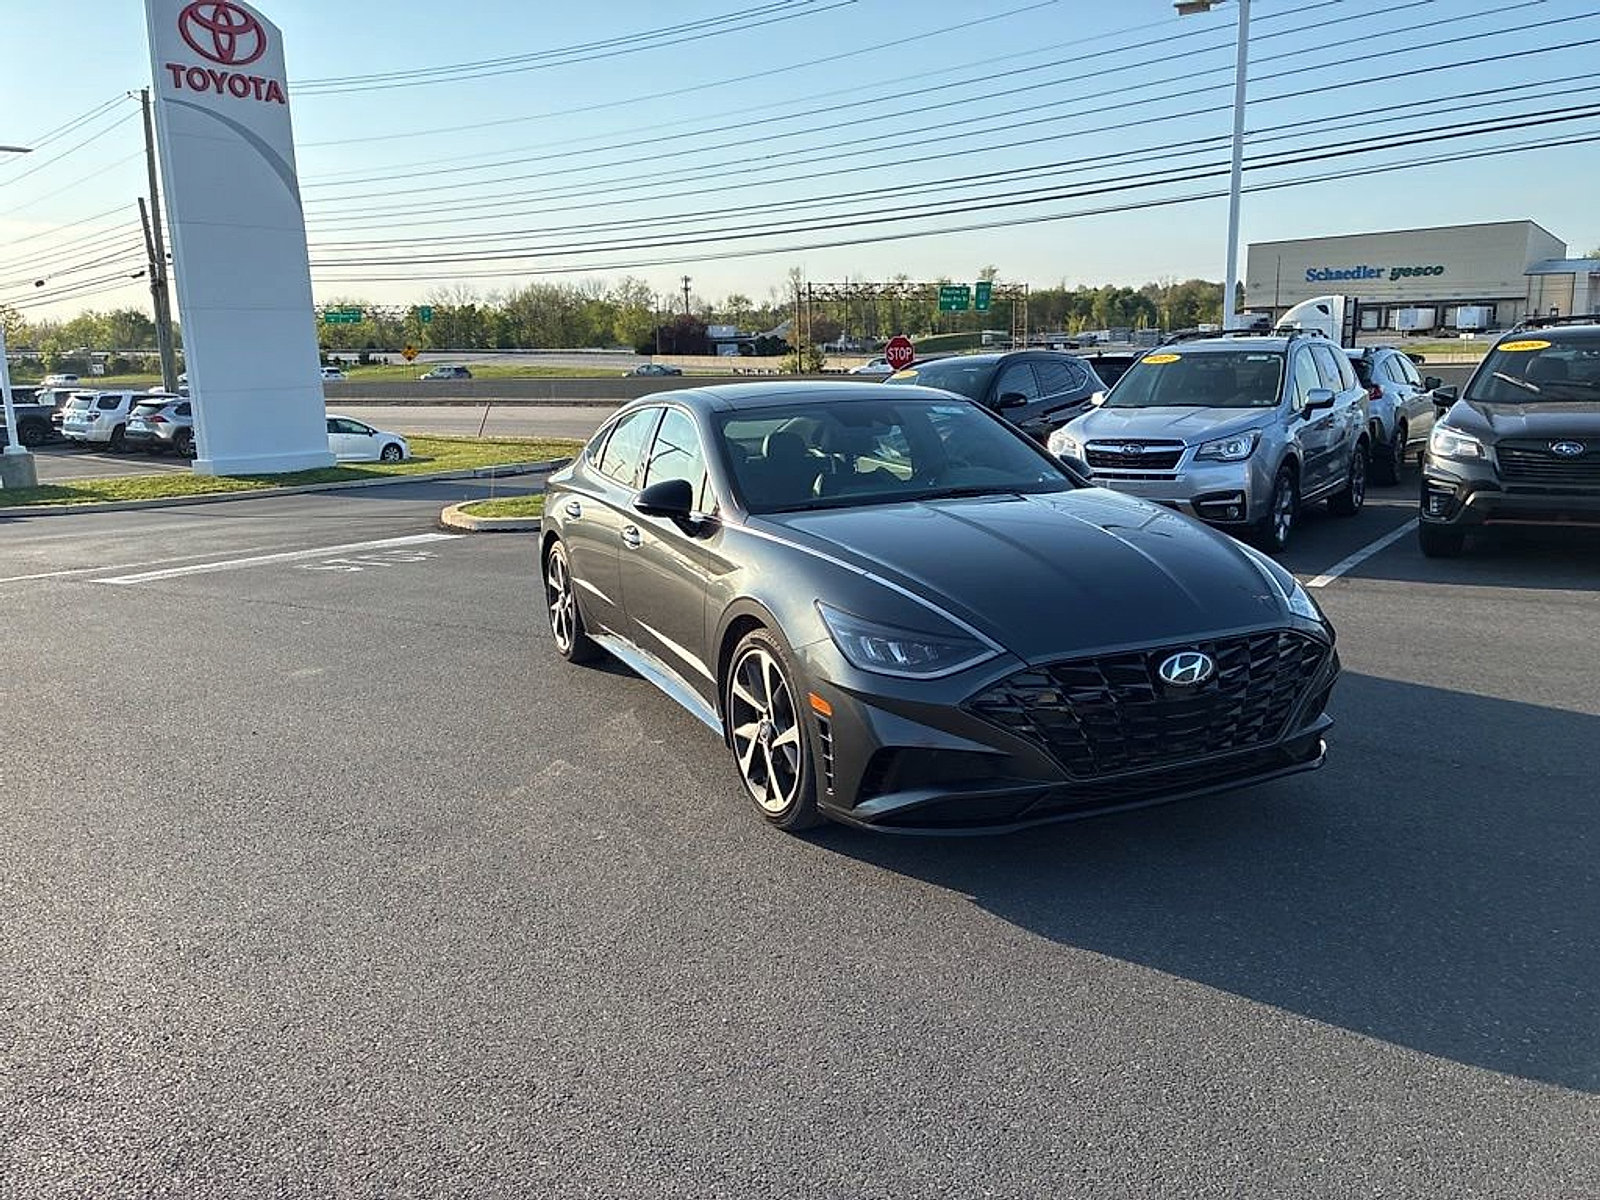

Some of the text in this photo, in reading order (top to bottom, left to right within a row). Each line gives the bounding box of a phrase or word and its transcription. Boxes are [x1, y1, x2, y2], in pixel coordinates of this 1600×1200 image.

[166, 63, 286, 104] TOYOTA
[1305, 265, 1385, 282] Schaedler
[887, 346, 913, 361] STOP
